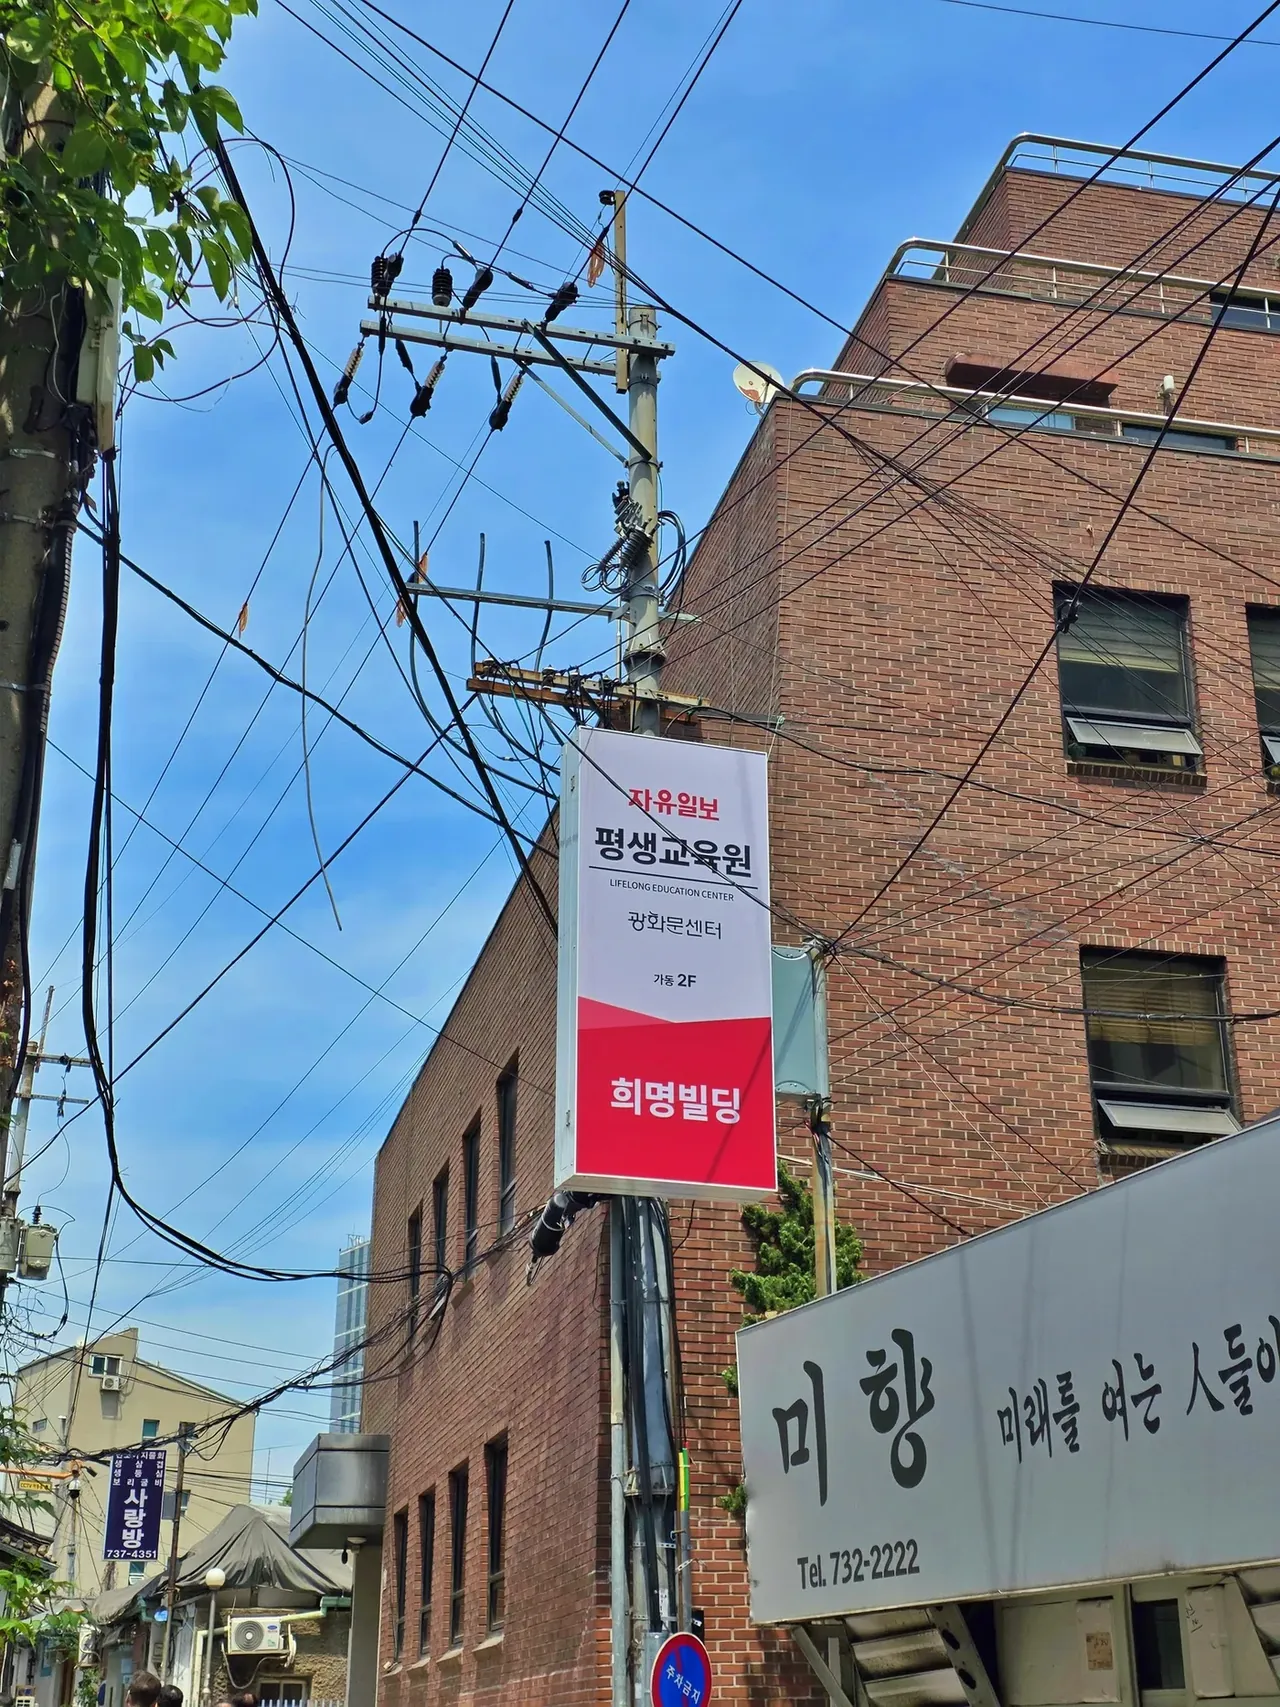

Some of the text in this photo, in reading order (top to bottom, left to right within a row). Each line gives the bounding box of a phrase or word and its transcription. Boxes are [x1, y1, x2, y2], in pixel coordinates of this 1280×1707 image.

[628, 788, 720, 822] 자유일보
[594, 826, 752, 878] 평생교육원
[609, 878, 734, 902] LIFELONG EDUCATION CENTER
[627, 910, 722, 940] 광화문센터
[653, 973, 697, 988] 가동 2F
[610, 1076, 741, 1125] 희명빌딩
[997, 1370, 1080, 1464] 미래를
[1101, 1352, 1162, 1441] 여는
[122, 1488, 148, 1549] 사랑방
[106, 1549, 157, 1559] 737-4351
[797, 1538, 920, 1590] Tel. 732-2222
[665, 1664, 701, 1705] 주차금지
